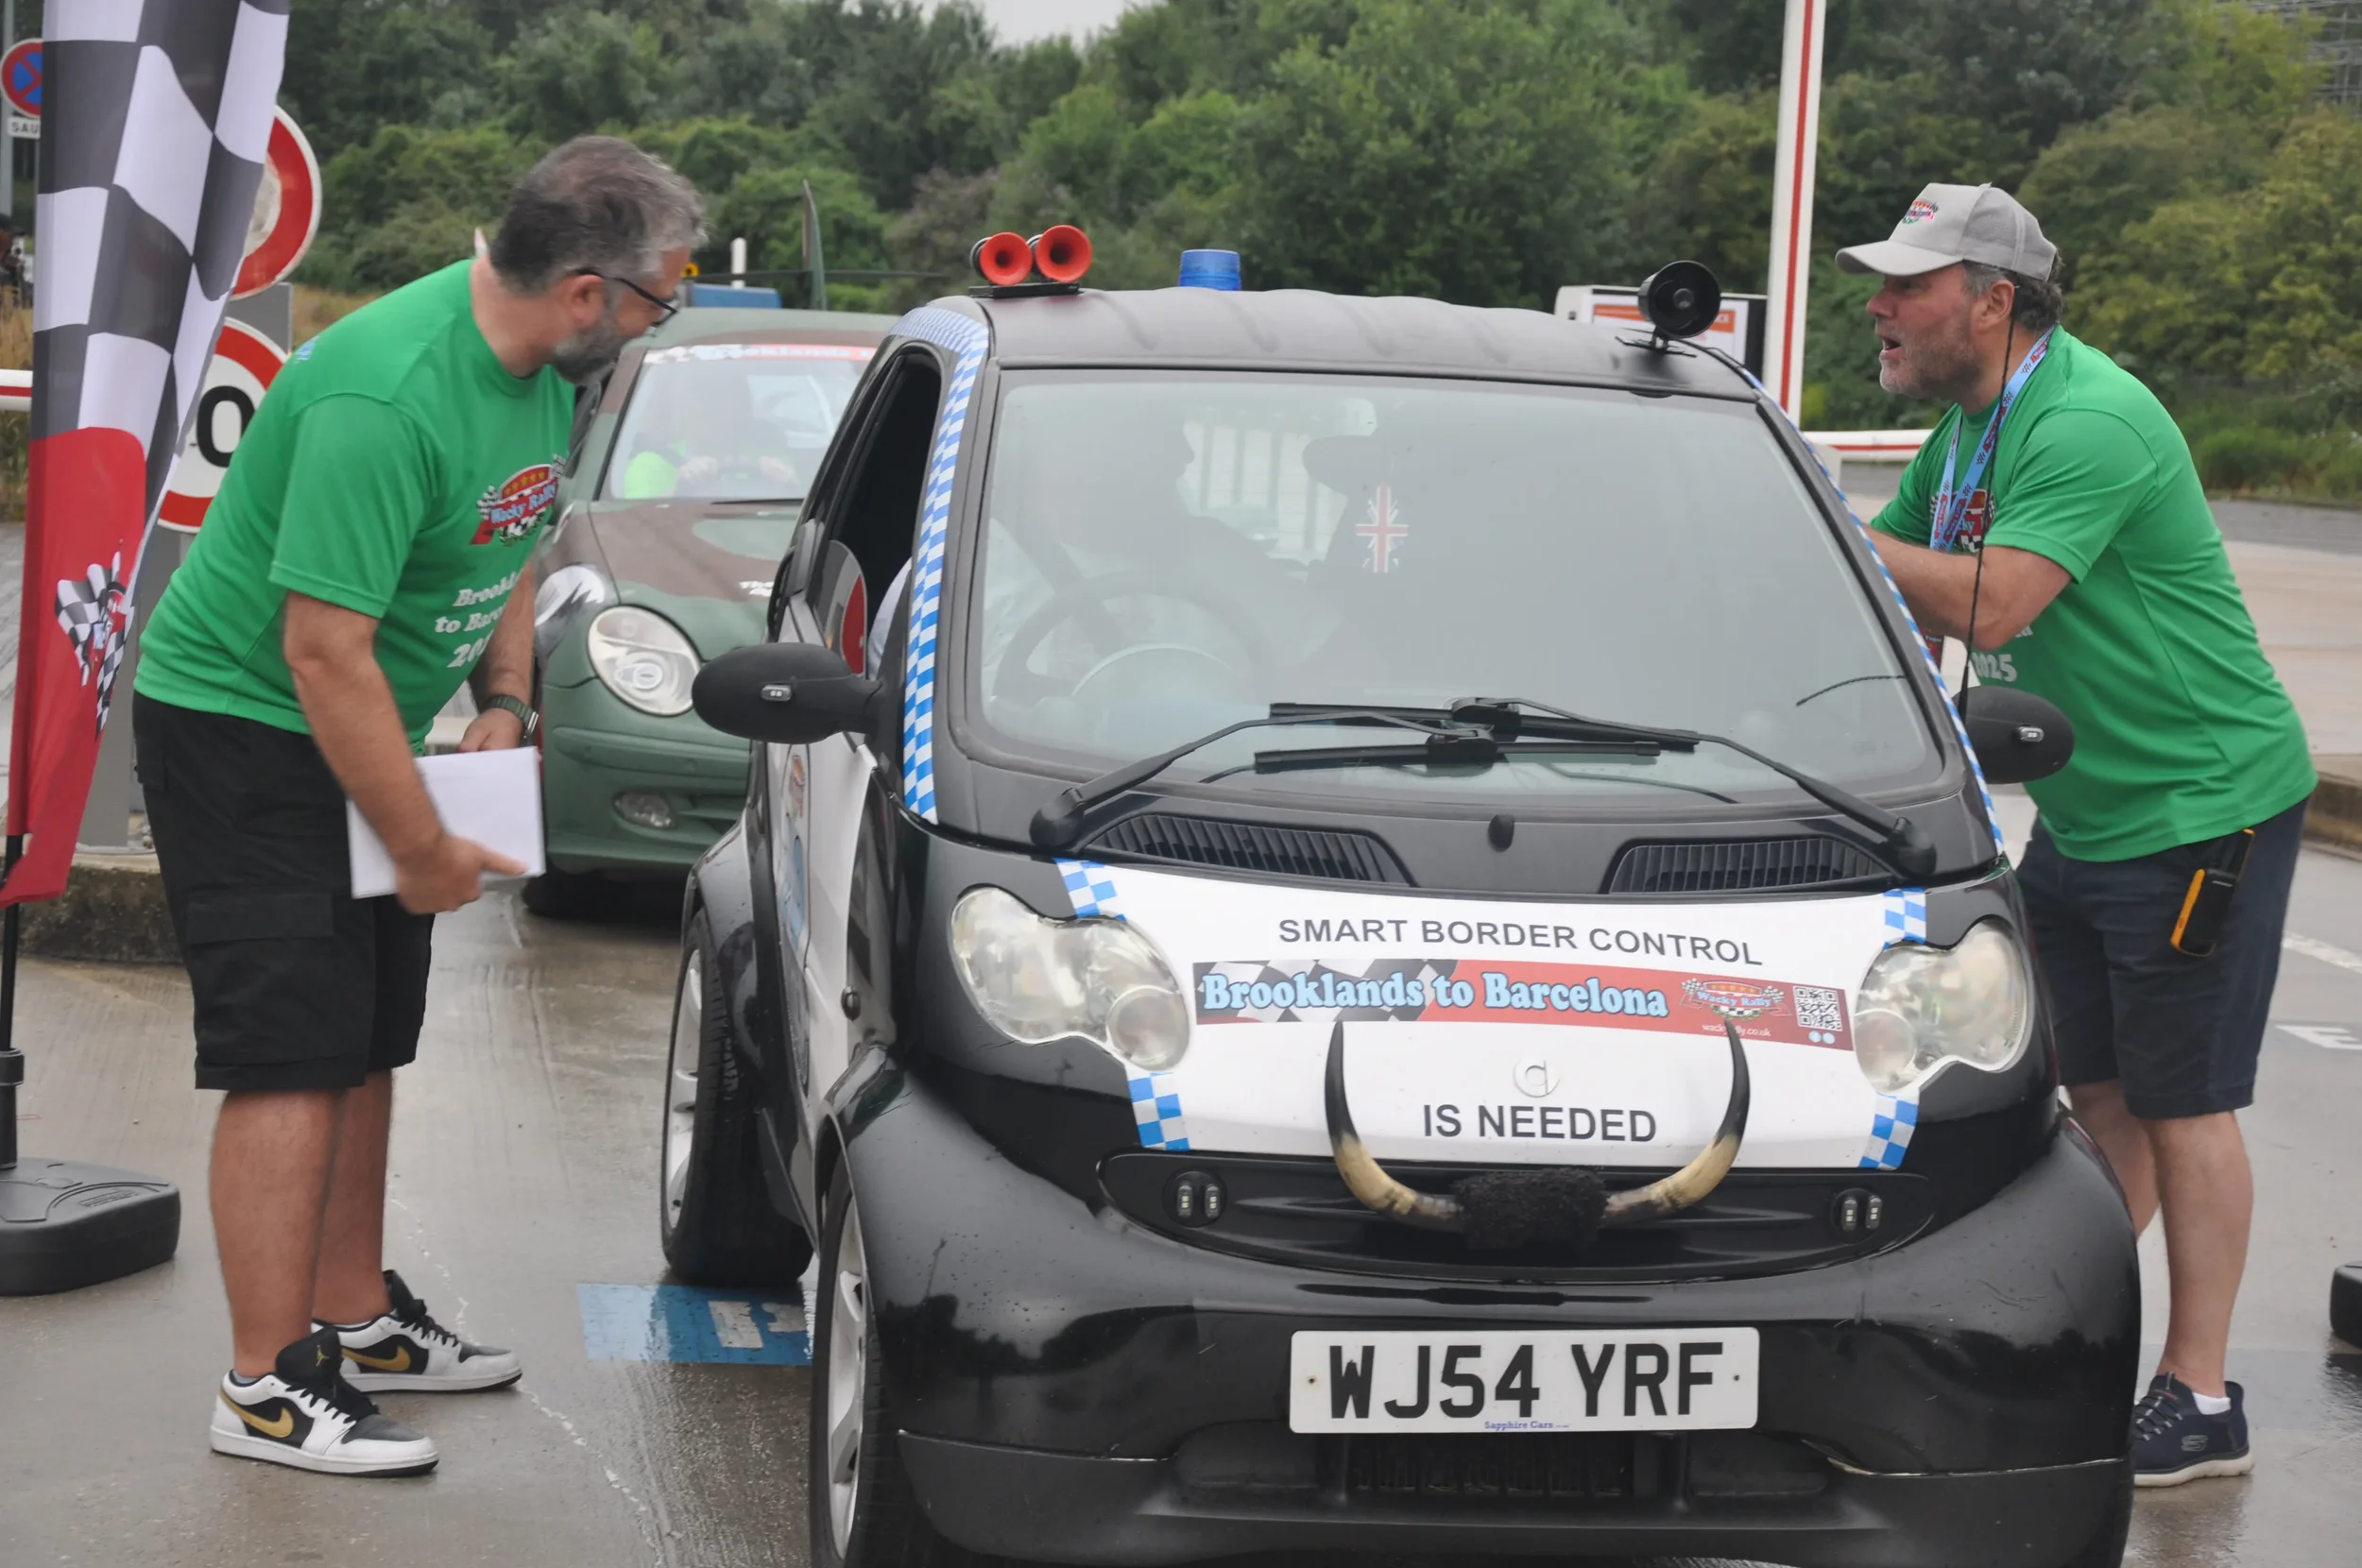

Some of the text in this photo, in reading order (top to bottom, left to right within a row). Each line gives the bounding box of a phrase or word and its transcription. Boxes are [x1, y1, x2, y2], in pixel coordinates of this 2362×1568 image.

[11, 121, 39, 134] SAU
[435, 616, 461, 633] to
[1278, 919, 1763, 966] SMART BORDER CONTROL
[1202, 971, 1669, 1018] Brooklands to Barcelona
[1697, 990, 1772, 1008] Wacky Rally
[1423, 1103, 1657, 1142] IS NEEDED
[1328, 1341, 1723, 1419] WJ54 YRF
[1483, 1421, 1528, 1431] Sapphire
[1530, 1420, 1554, 1429] Cars
